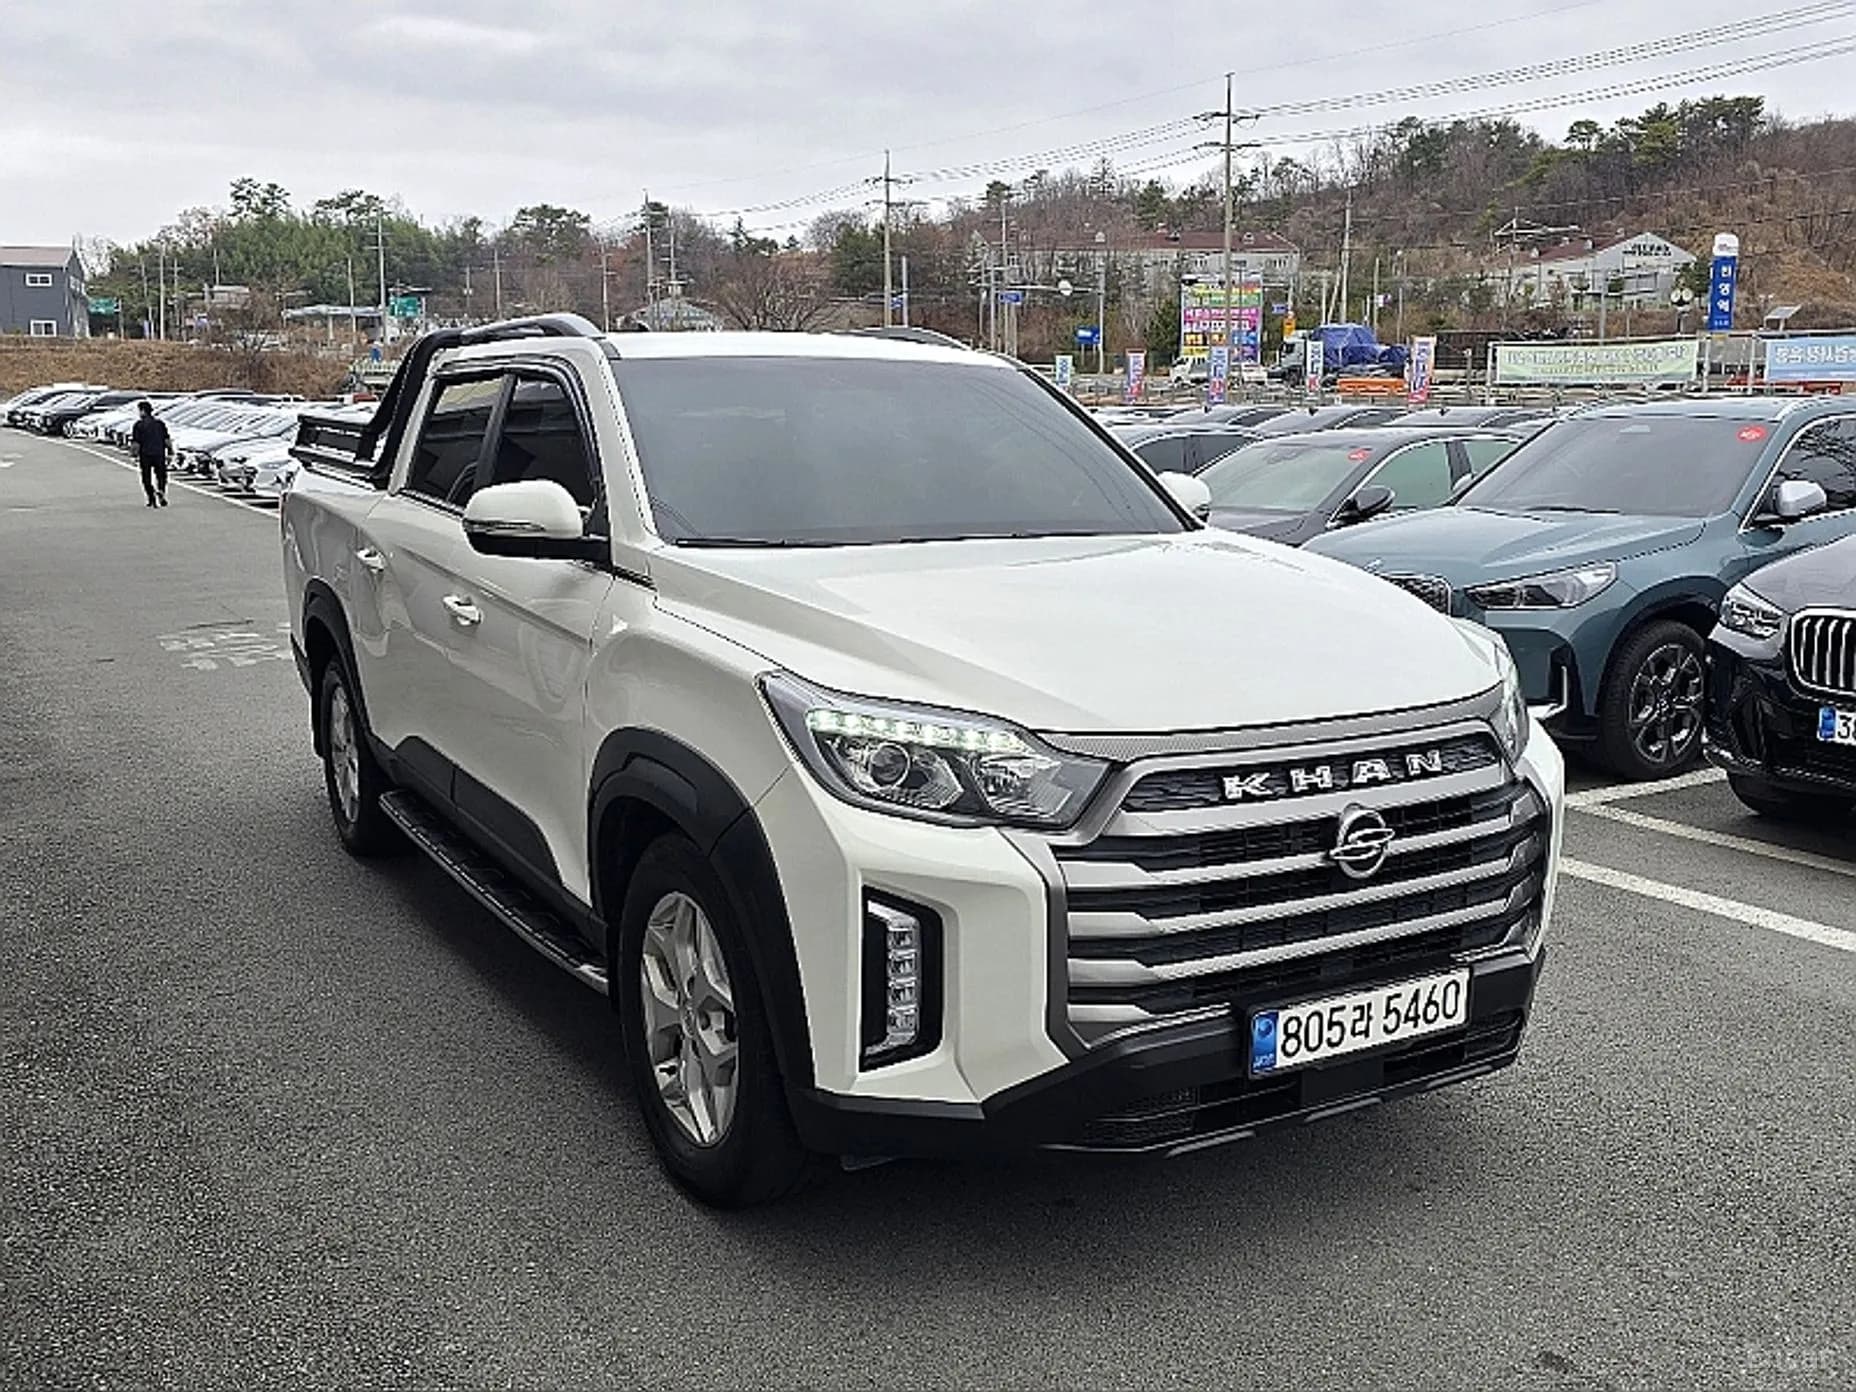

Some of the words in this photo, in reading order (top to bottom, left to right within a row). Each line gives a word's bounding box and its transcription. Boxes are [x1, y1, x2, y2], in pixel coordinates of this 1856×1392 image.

[1837, 714, 1856, 741] 3
[1222, 749, 1443, 801] KHAN
[1280, 1001, 1373, 1058] 805라
[1382, 979, 1461, 1035] 5460
